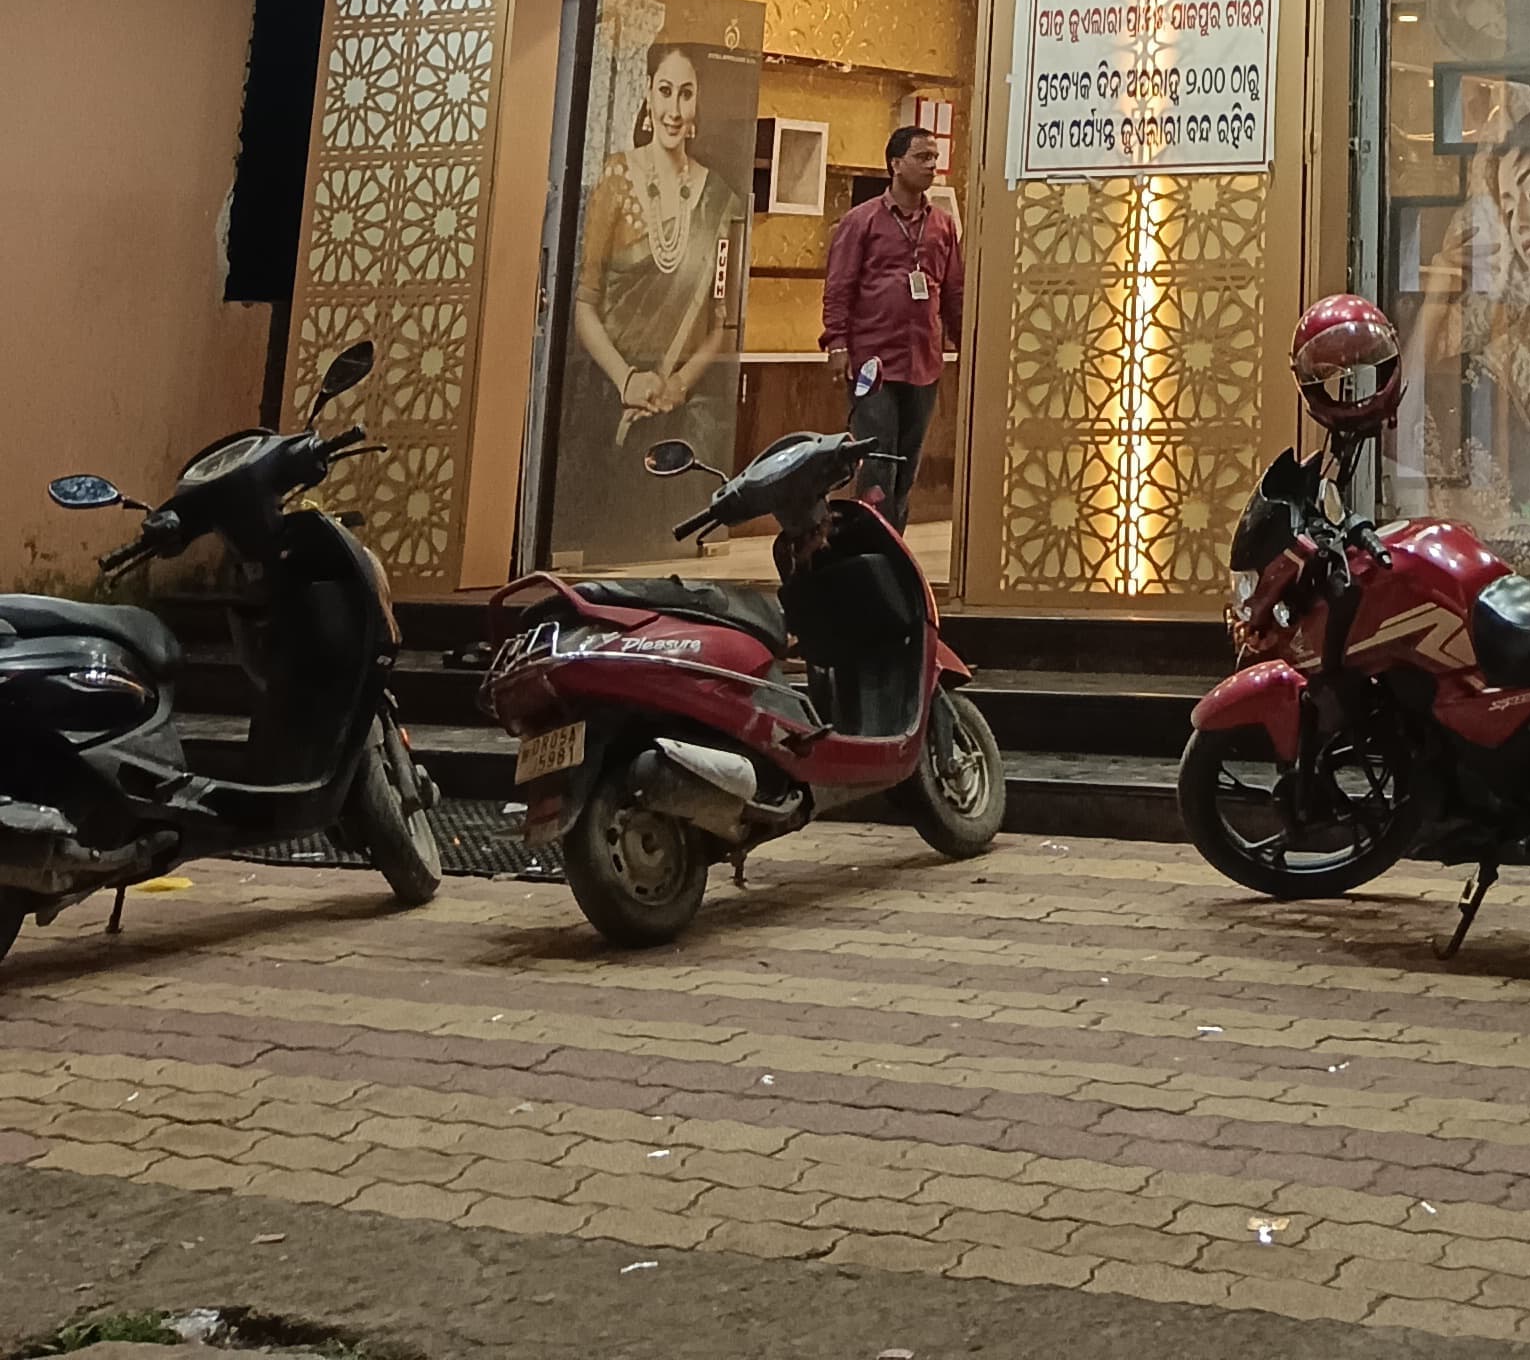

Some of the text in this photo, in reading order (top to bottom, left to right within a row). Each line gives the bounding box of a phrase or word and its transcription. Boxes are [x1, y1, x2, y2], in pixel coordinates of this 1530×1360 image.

[1039, 9, 1064, 41] ପାତ୍ର
[1096, 60, 1122, 99] ଦିନ
[716, 242, 727, 296] PUSH
[621, 636, 701, 653] Pleasure
